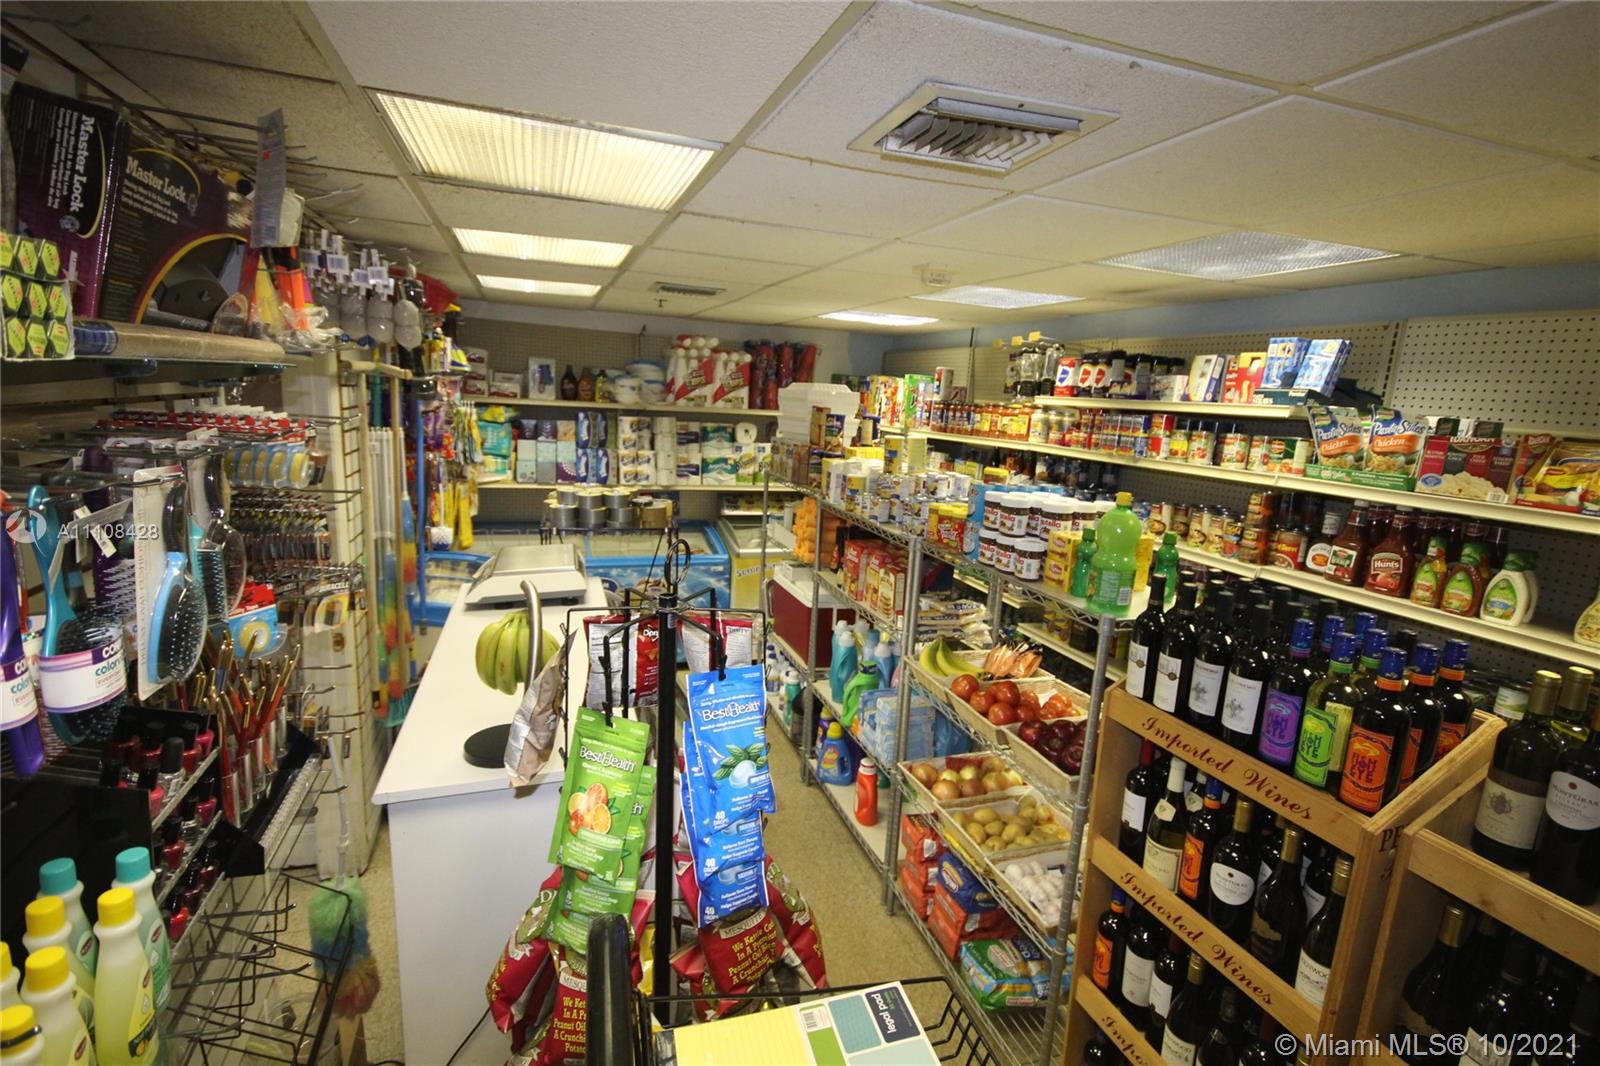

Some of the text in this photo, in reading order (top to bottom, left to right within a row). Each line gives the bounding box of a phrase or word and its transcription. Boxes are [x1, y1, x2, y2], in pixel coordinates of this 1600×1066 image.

[70, 113, 96, 213] Master Lock
[125, 155, 163, 190] Master
[163, 176, 187, 204] Lock
[1142, 716, 1313, 820] Imported Wines
[705, 858, 716, 867] 40
[705, 906, 715, 915] 40
[1121, 872, 1273, 1006] Imported Wines
[732, 942, 744, 953] We
[736, 950, 745, 961] In
[728, 956, 752, 977] Peanut
[563, 996, 573, 1007] We
[563, 1009, 571, 1019] In
[572, 1010, 580, 1019] A
[870, 993, 897, 1034] legal pad
[553, 1018, 575, 1031] Peanut
[553, 1030, 559, 1039] A
